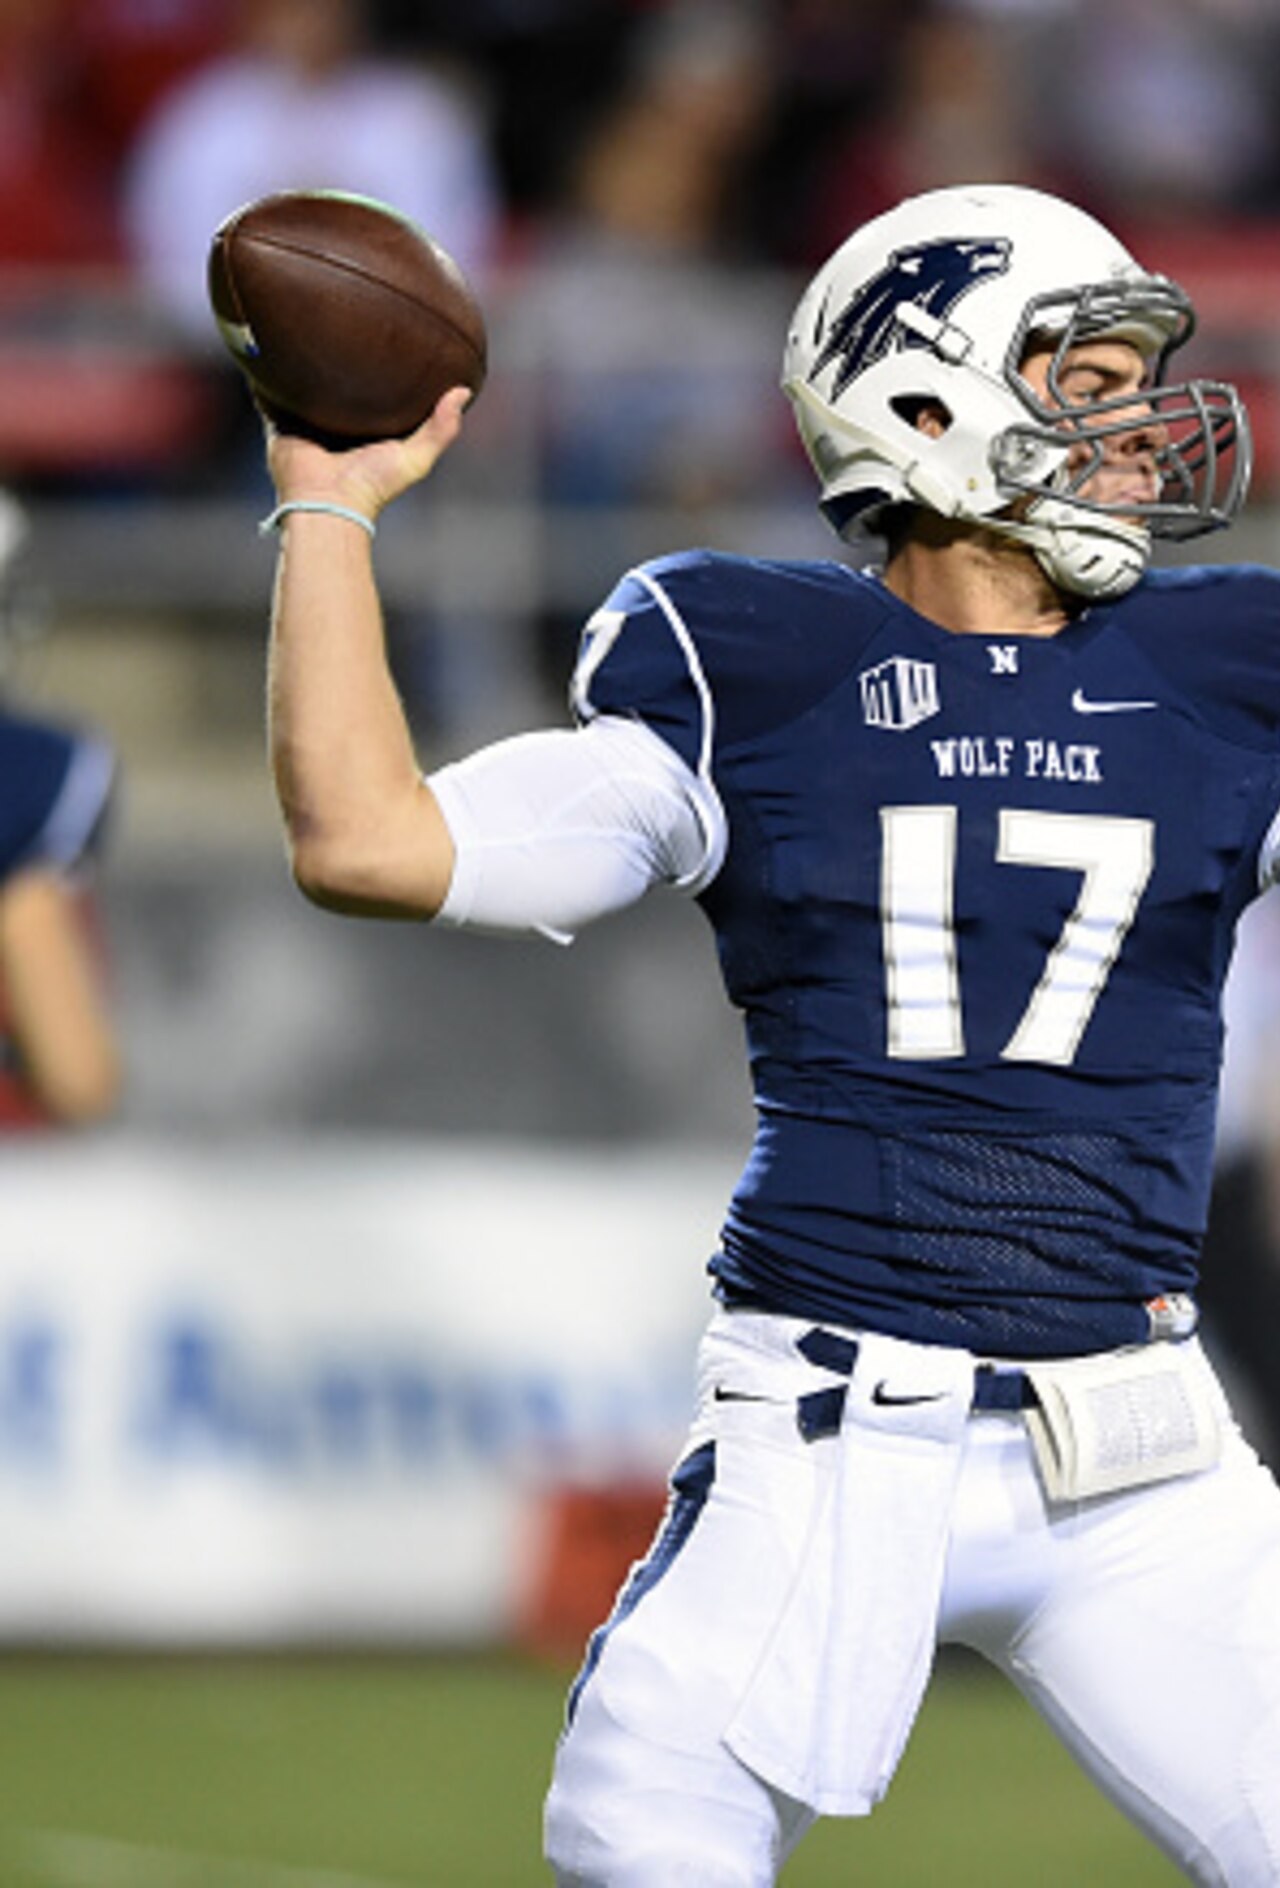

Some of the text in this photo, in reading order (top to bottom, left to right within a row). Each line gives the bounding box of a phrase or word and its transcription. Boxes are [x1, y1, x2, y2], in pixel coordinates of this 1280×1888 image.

[986, 645, 1019, 674] N
[930, 738, 1103, 783] WOLF PACK
[879, 805, 1156, 1067] 17
